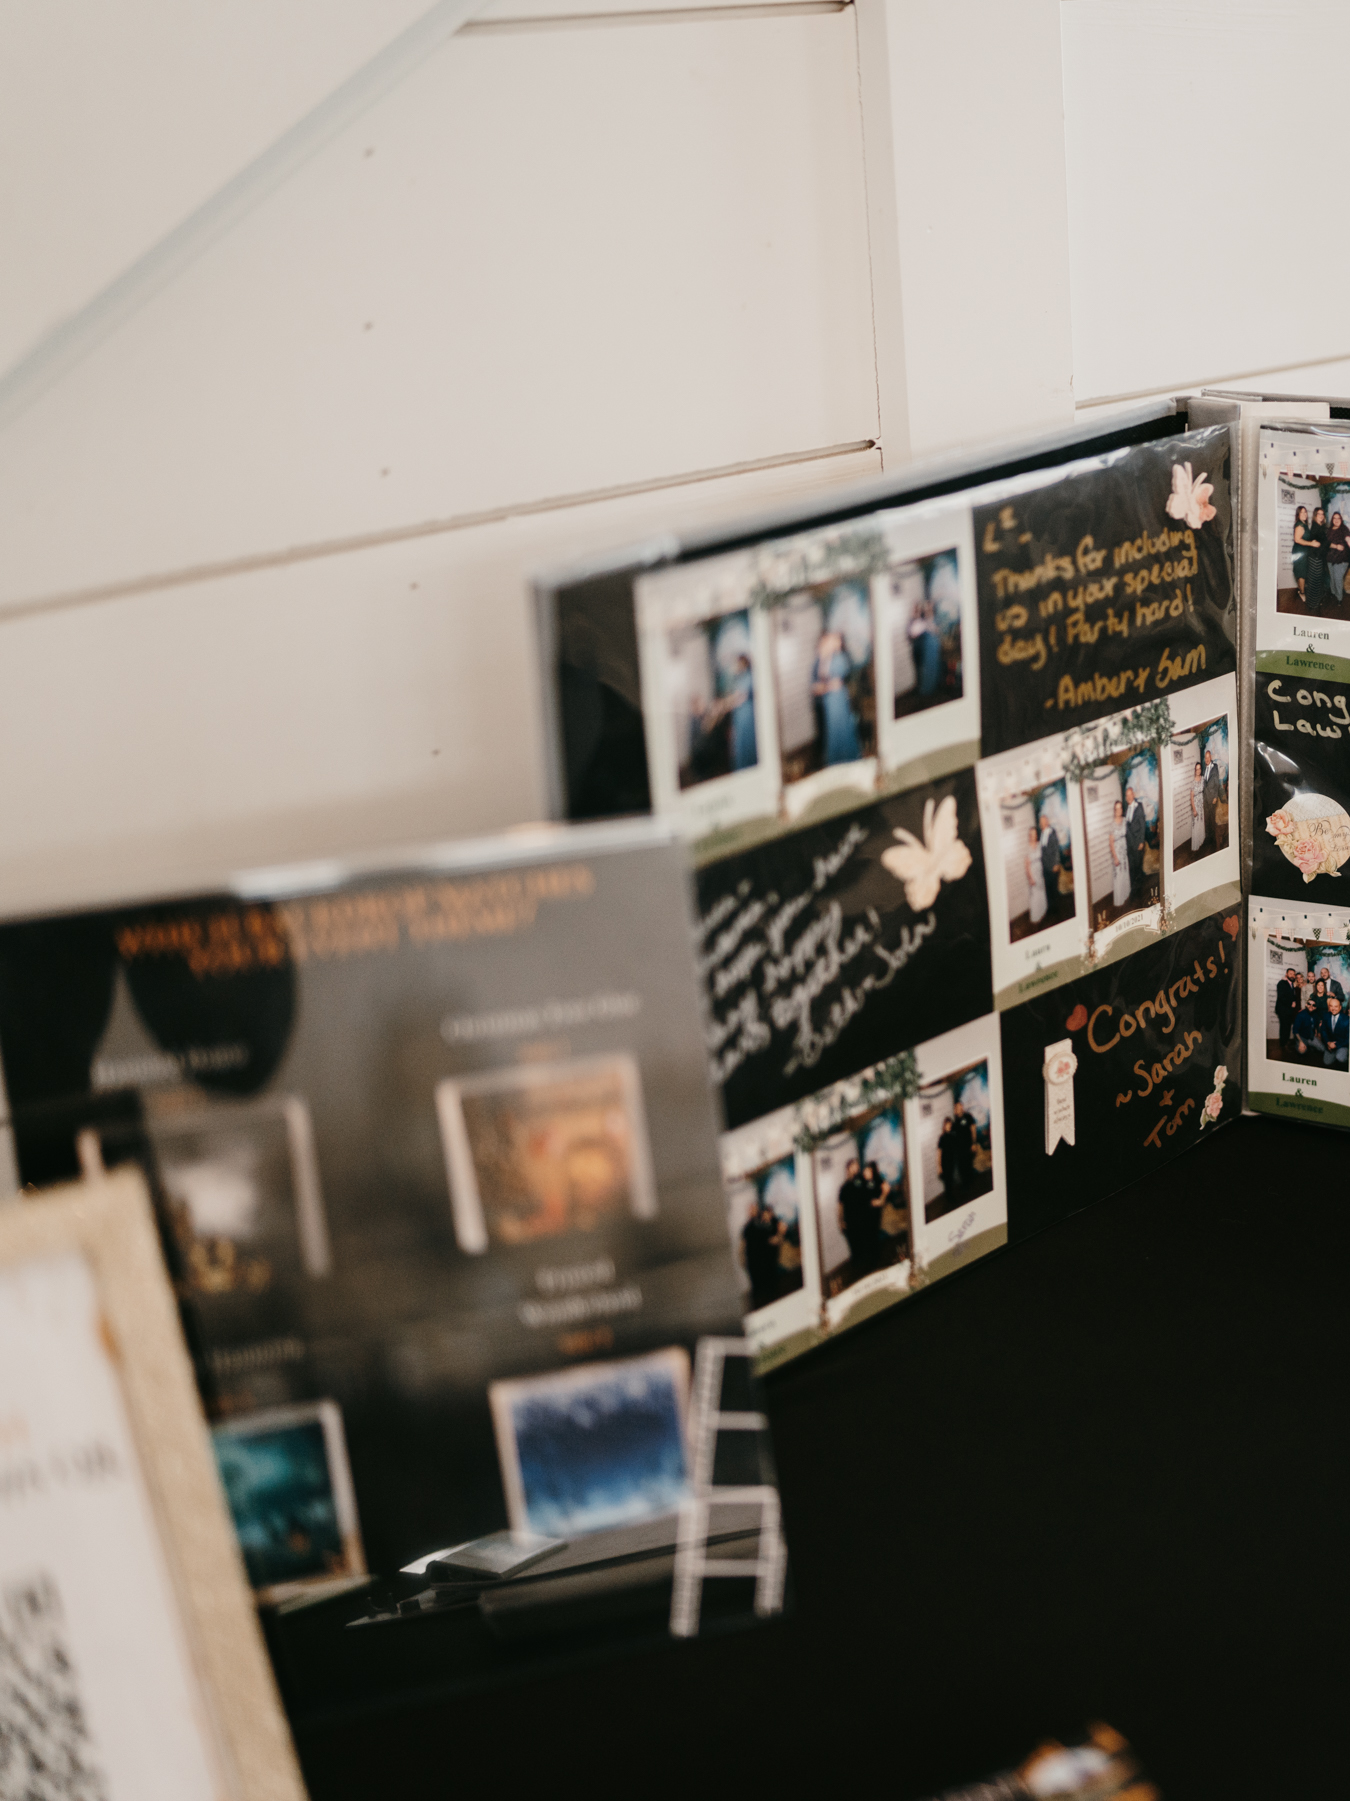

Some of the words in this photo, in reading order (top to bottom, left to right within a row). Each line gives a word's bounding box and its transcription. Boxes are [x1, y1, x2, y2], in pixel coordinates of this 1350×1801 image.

[993, 553, 1075, 598] Thanks
[1077, 534, 1107, 576] for
[1113, 527, 1196, 569] including
[995, 604, 1029, 632] us
[1039, 591, 1063, 618] in
[1066, 577, 1119, 612] your
[1123, 547, 1198, 596] special
[997, 625, 1059, 670] day!
[1066, 608, 1129, 645] Party
[1136, 583, 1194, 627] hard!
[1292, 626, 1330, 640] Lauren
[1286, 655, 1336, 671] Lawrence
[1306, 643, 1315, 653] &
[1155, 643, 1206, 689] Sam
[1309, 820, 1331, 837] Be
[1087, 940, 1228, 1053] Congrats!
[1133, 1030, 1202, 1097] Sarah
[1282, 1072, 1317, 1086] Lauren
[1276, 1097, 1323, 1114] Lawrence
[1295, 1088, 1304, 1098] &
[1143, 1098, 1195, 1148] Tom
